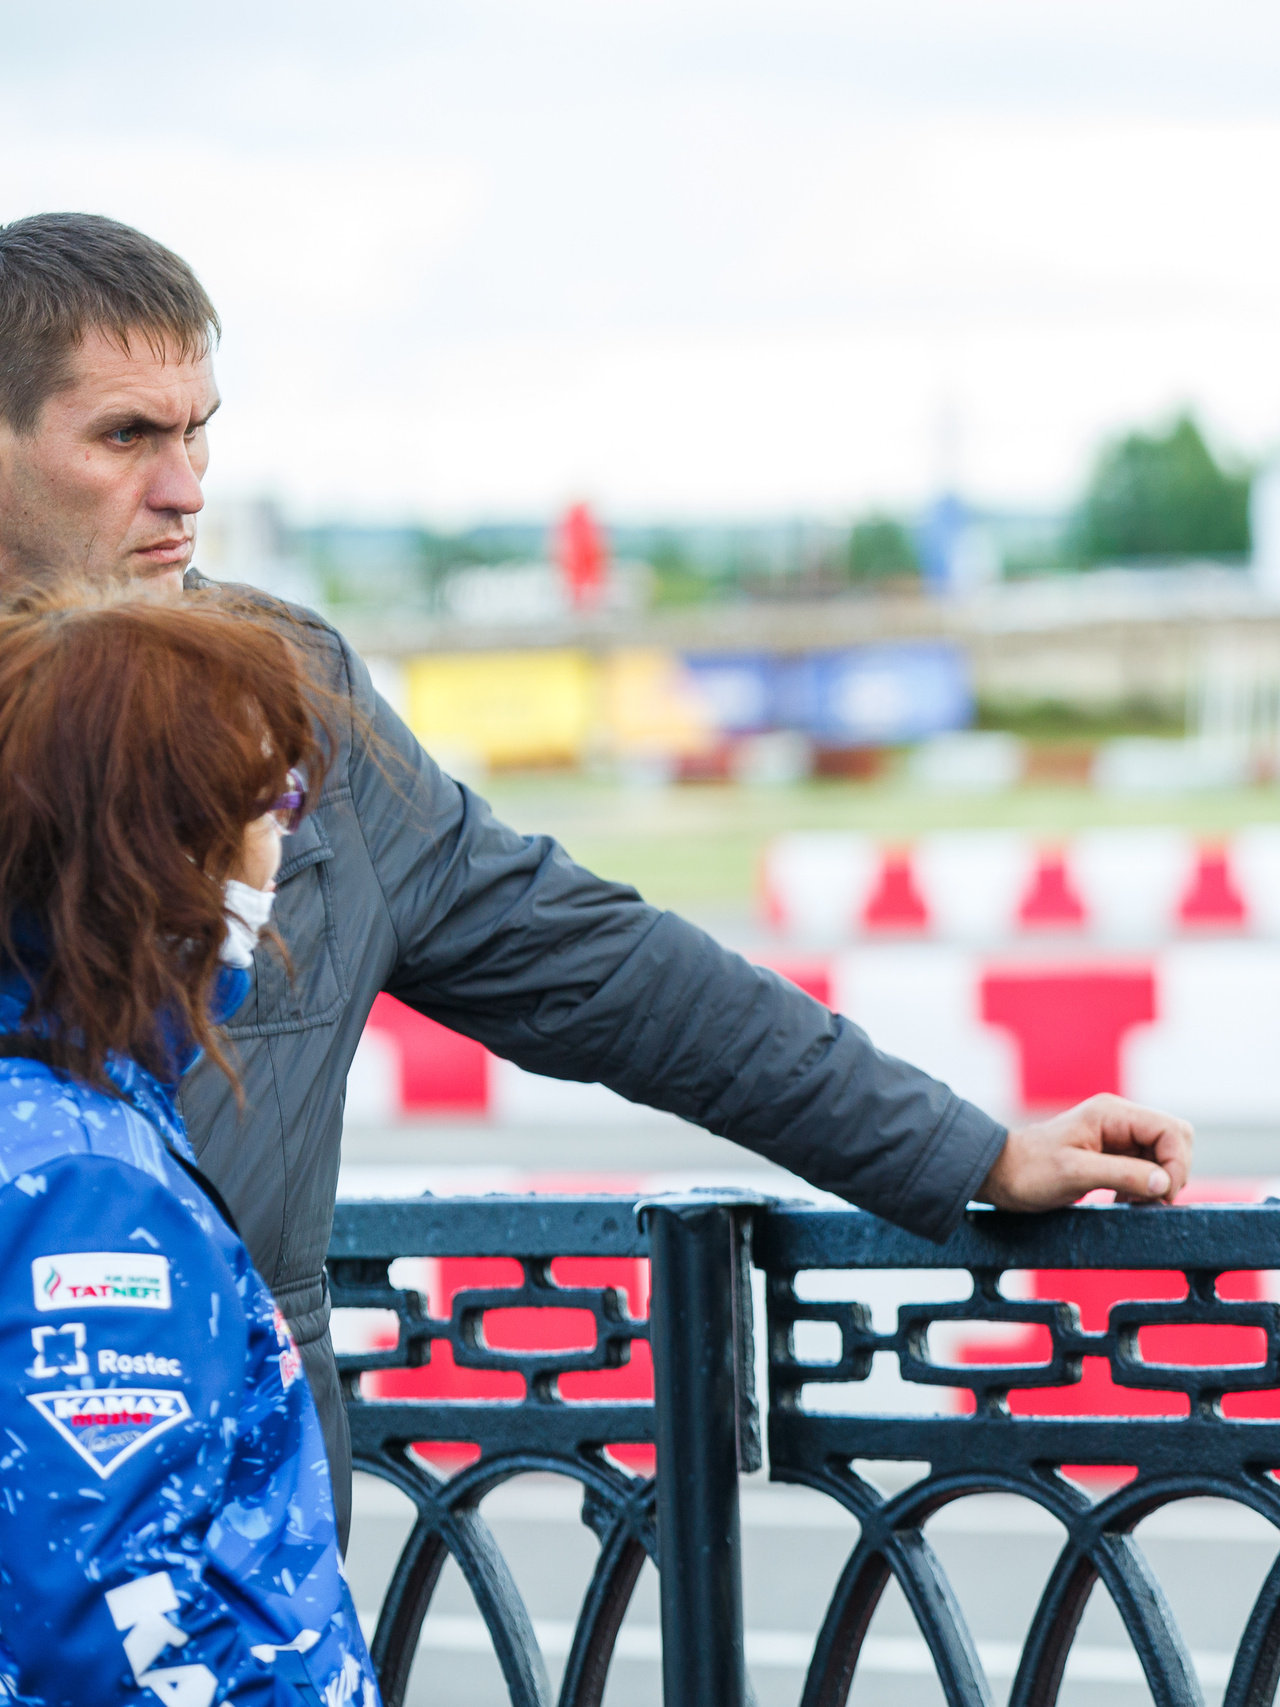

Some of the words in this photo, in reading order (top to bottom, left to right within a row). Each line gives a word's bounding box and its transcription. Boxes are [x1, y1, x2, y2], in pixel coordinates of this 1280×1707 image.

[67, 1285, 161, 1299] TATNEFT
[98, 1349, 182, 1377] Rostec
[54, 1396, 177, 1419] KAMAZ
[72, 1410, 153, 1427] master
